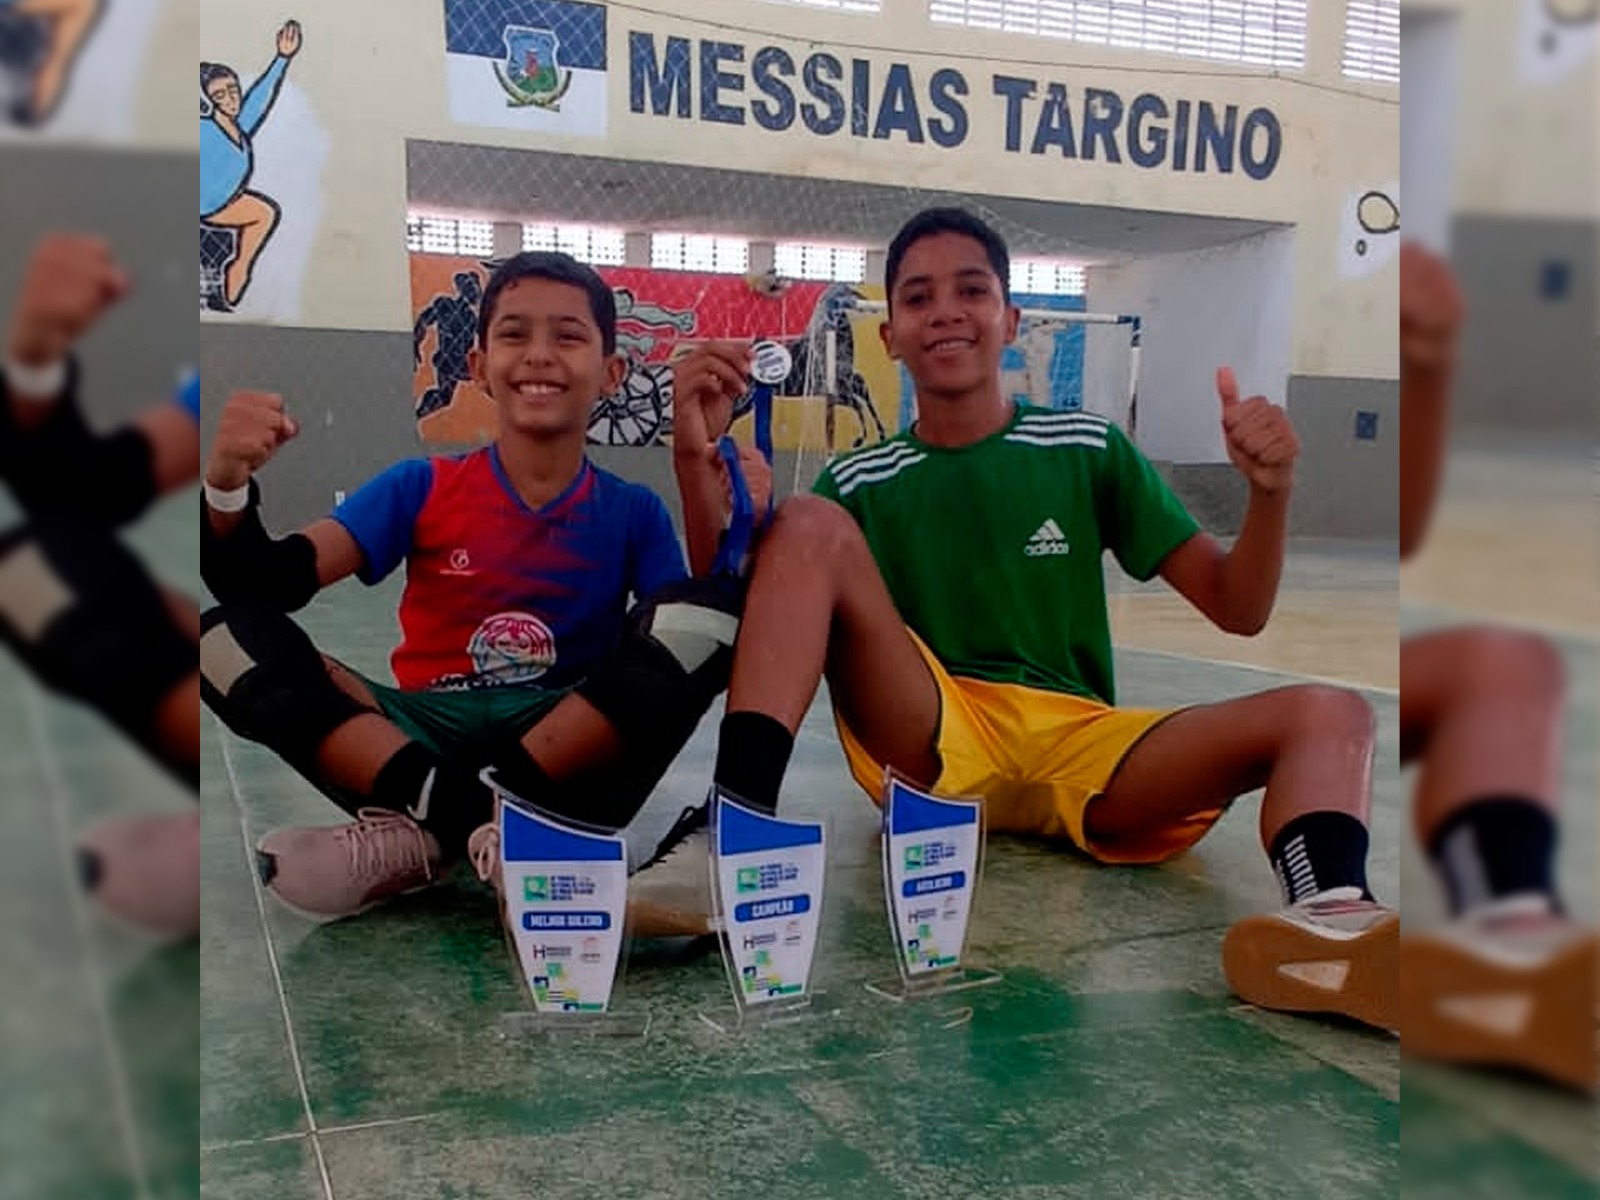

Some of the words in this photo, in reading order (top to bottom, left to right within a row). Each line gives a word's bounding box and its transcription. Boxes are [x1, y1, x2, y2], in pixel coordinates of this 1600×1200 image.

[628, 30, 970, 149] MESSIAS
[992, 73, 1282, 181] TARGINO
[1024, 541, 1070, 556] adidas
